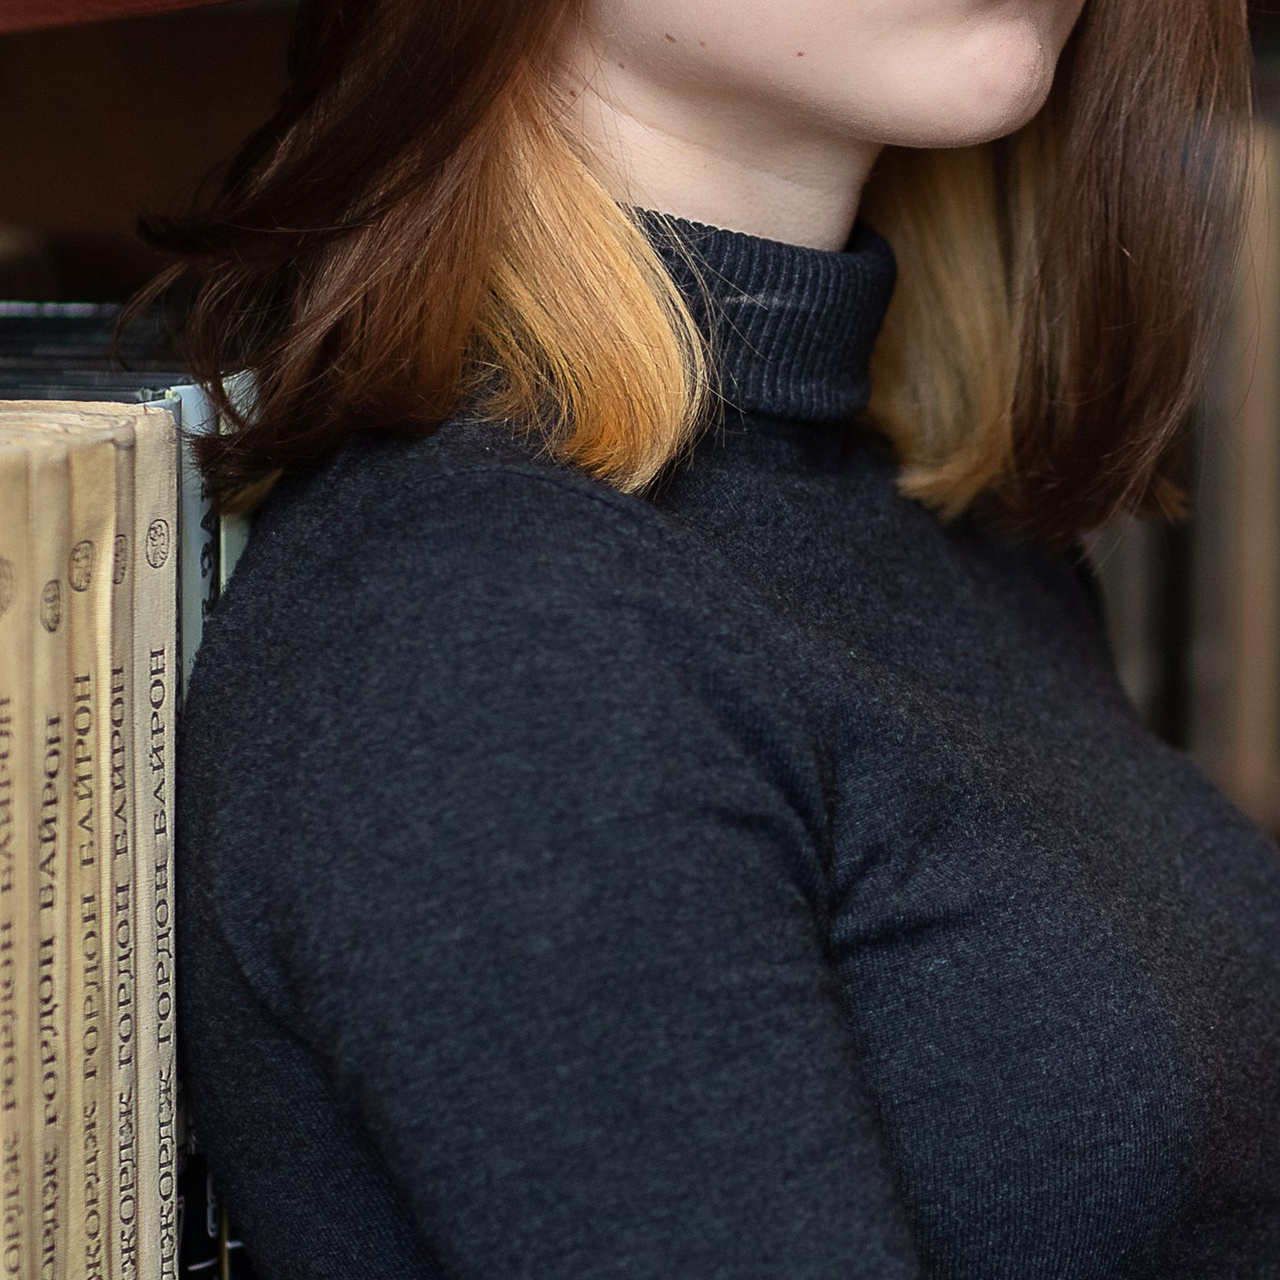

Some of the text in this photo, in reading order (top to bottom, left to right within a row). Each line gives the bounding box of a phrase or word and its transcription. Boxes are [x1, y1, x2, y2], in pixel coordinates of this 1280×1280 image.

[37, 715, 62, 911] БАЙРОН
[72, 671, 95, 867] БАЙРОН
[110, 665, 129, 859] БАЙРОН
[38, 936, 60, 1126] ГОРДОН
[80, 894, 103, 1080] ГОРДОН
[115, 882, 134, 1069] ГОРДОН
[149, 646, 176, 1280] ДЖОРДЖ ГОРДОН БАЙРОН
